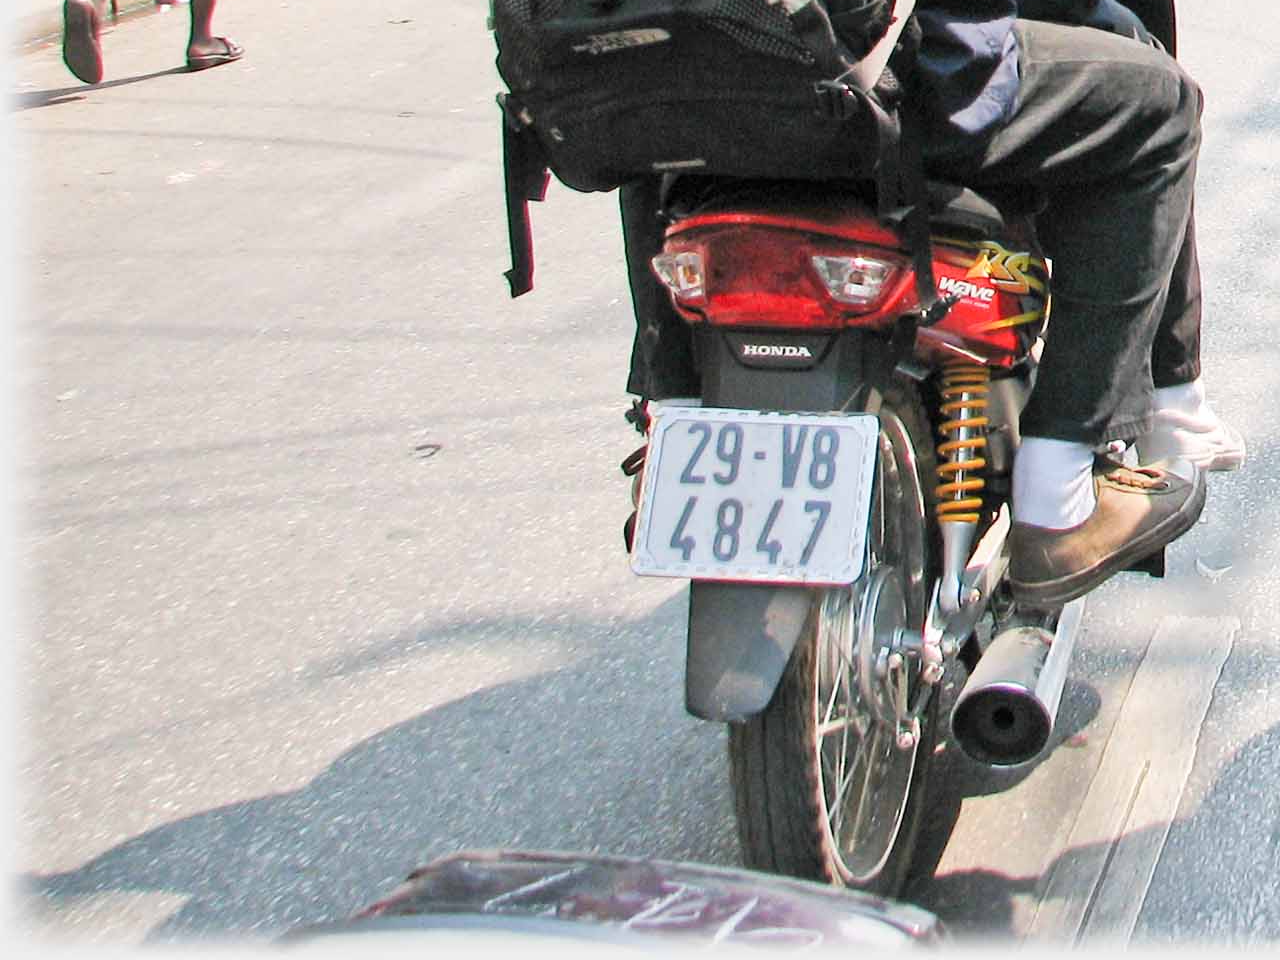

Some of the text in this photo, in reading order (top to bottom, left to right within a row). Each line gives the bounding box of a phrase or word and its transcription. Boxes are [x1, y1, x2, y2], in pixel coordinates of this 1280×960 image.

[743, 344, 812, 357] HONDA
[680, 422, 840, 490] 29-V8
[670, 496, 832, 567] 4847
